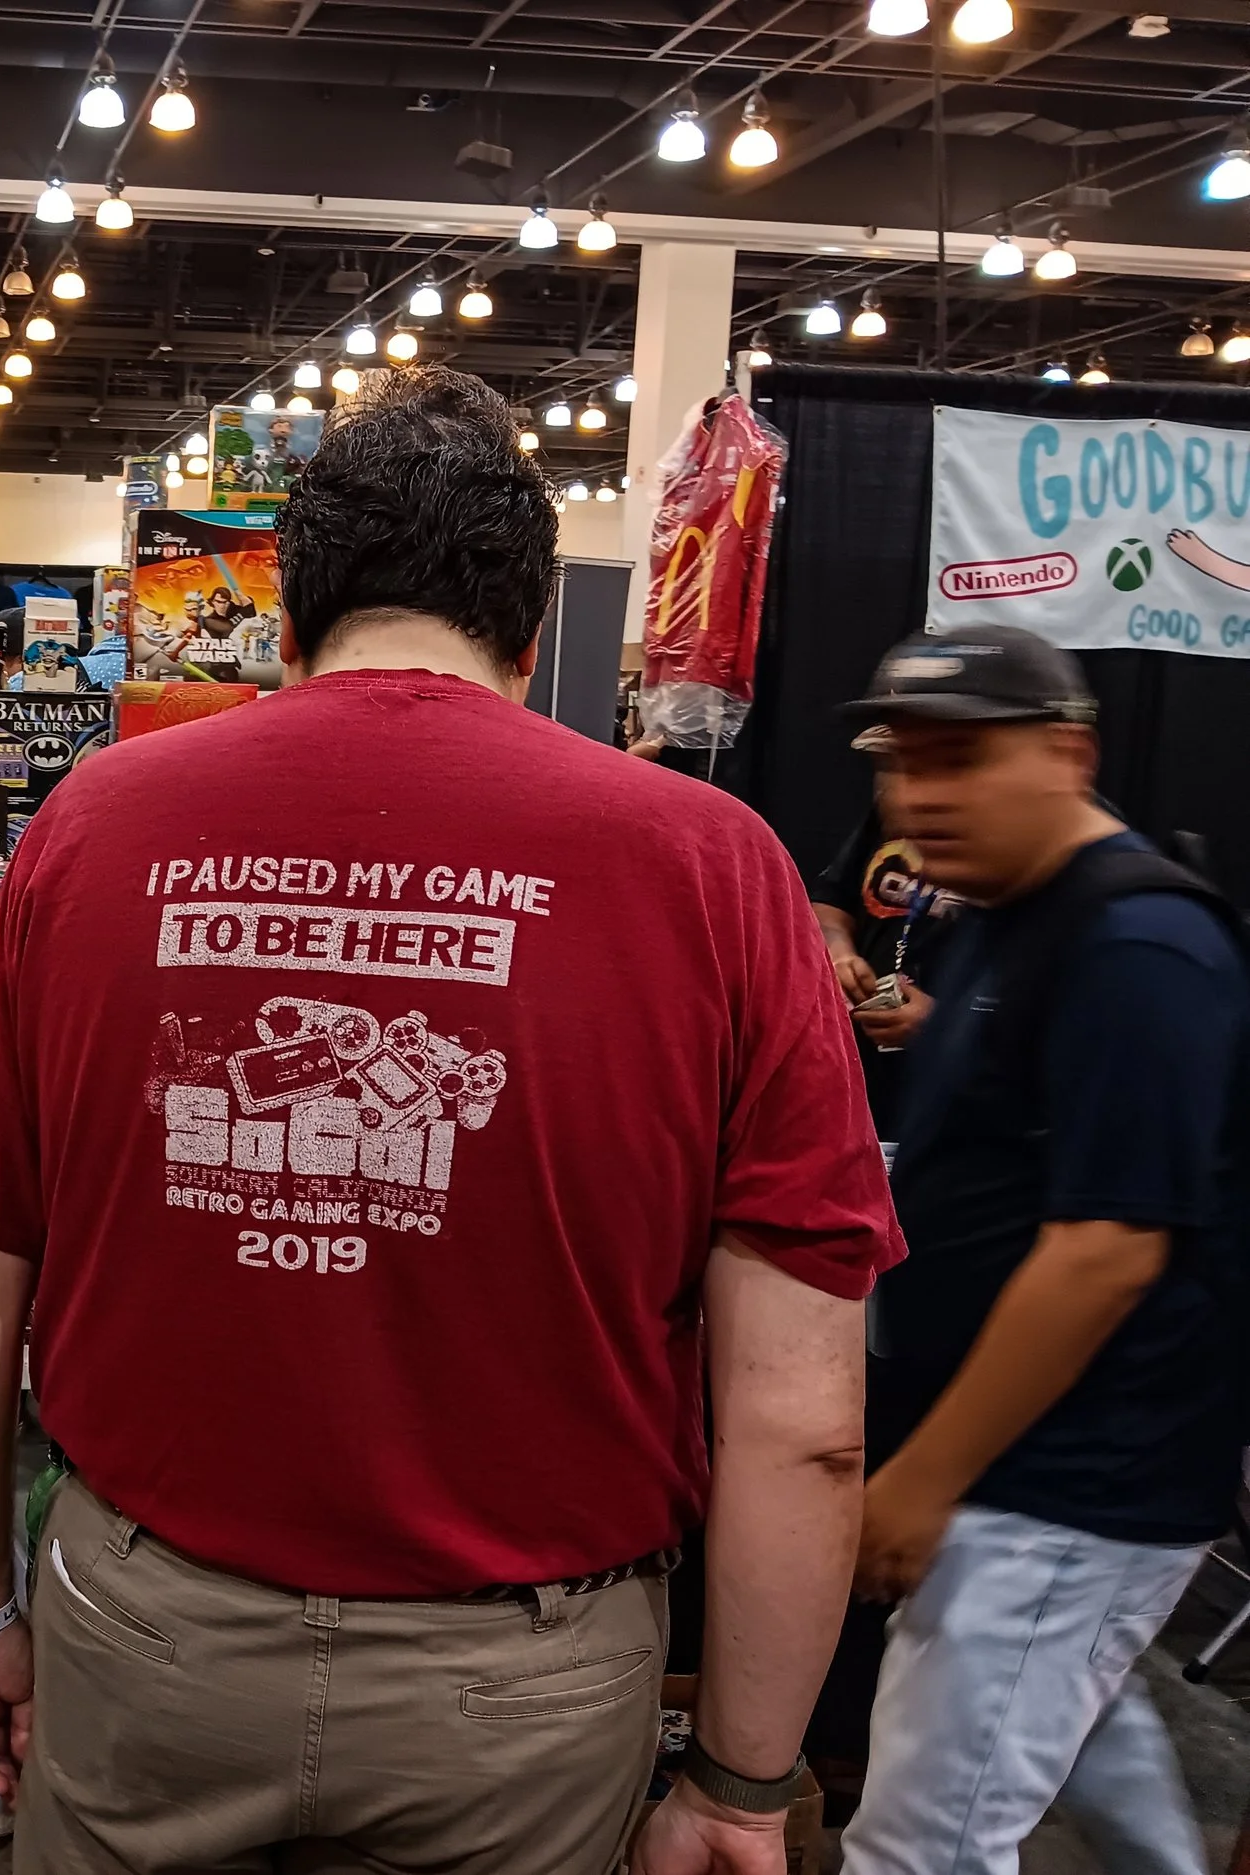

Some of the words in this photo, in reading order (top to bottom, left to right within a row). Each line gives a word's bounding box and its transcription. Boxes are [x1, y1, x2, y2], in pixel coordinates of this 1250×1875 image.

[138, 546, 202, 558] INFINITY
[151, 530, 189, 546] Disney
[953, 563, 1064, 592] Nintendo
[1127, 603, 1200, 647] GOOD
[187, 638, 237, 651] STAR
[187, 650, 237, 663] WARS
[13, 721, 83, 732] RETURNS
[147, 862, 160, 897] I
[164, 856, 337, 896] PAUSED
[345, 862, 414, 900] MY
[424, 866, 556, 916] GAME
[173, 913, 244, 956] TO
[255, 914, 332, 959] BE
[341, 921, 500, 973] HERE
[165, 1164, 279, 1196] SOUTHERN
[293, 1178, 448, 1213] CALIFORNIA
[166, 1186, 245, 1215] RETRO
[250, 1198, 361, 1225] GAMING
[367, 1204, 442, 1236] EXPO
[237, 1230, 368, 1274] 2019
